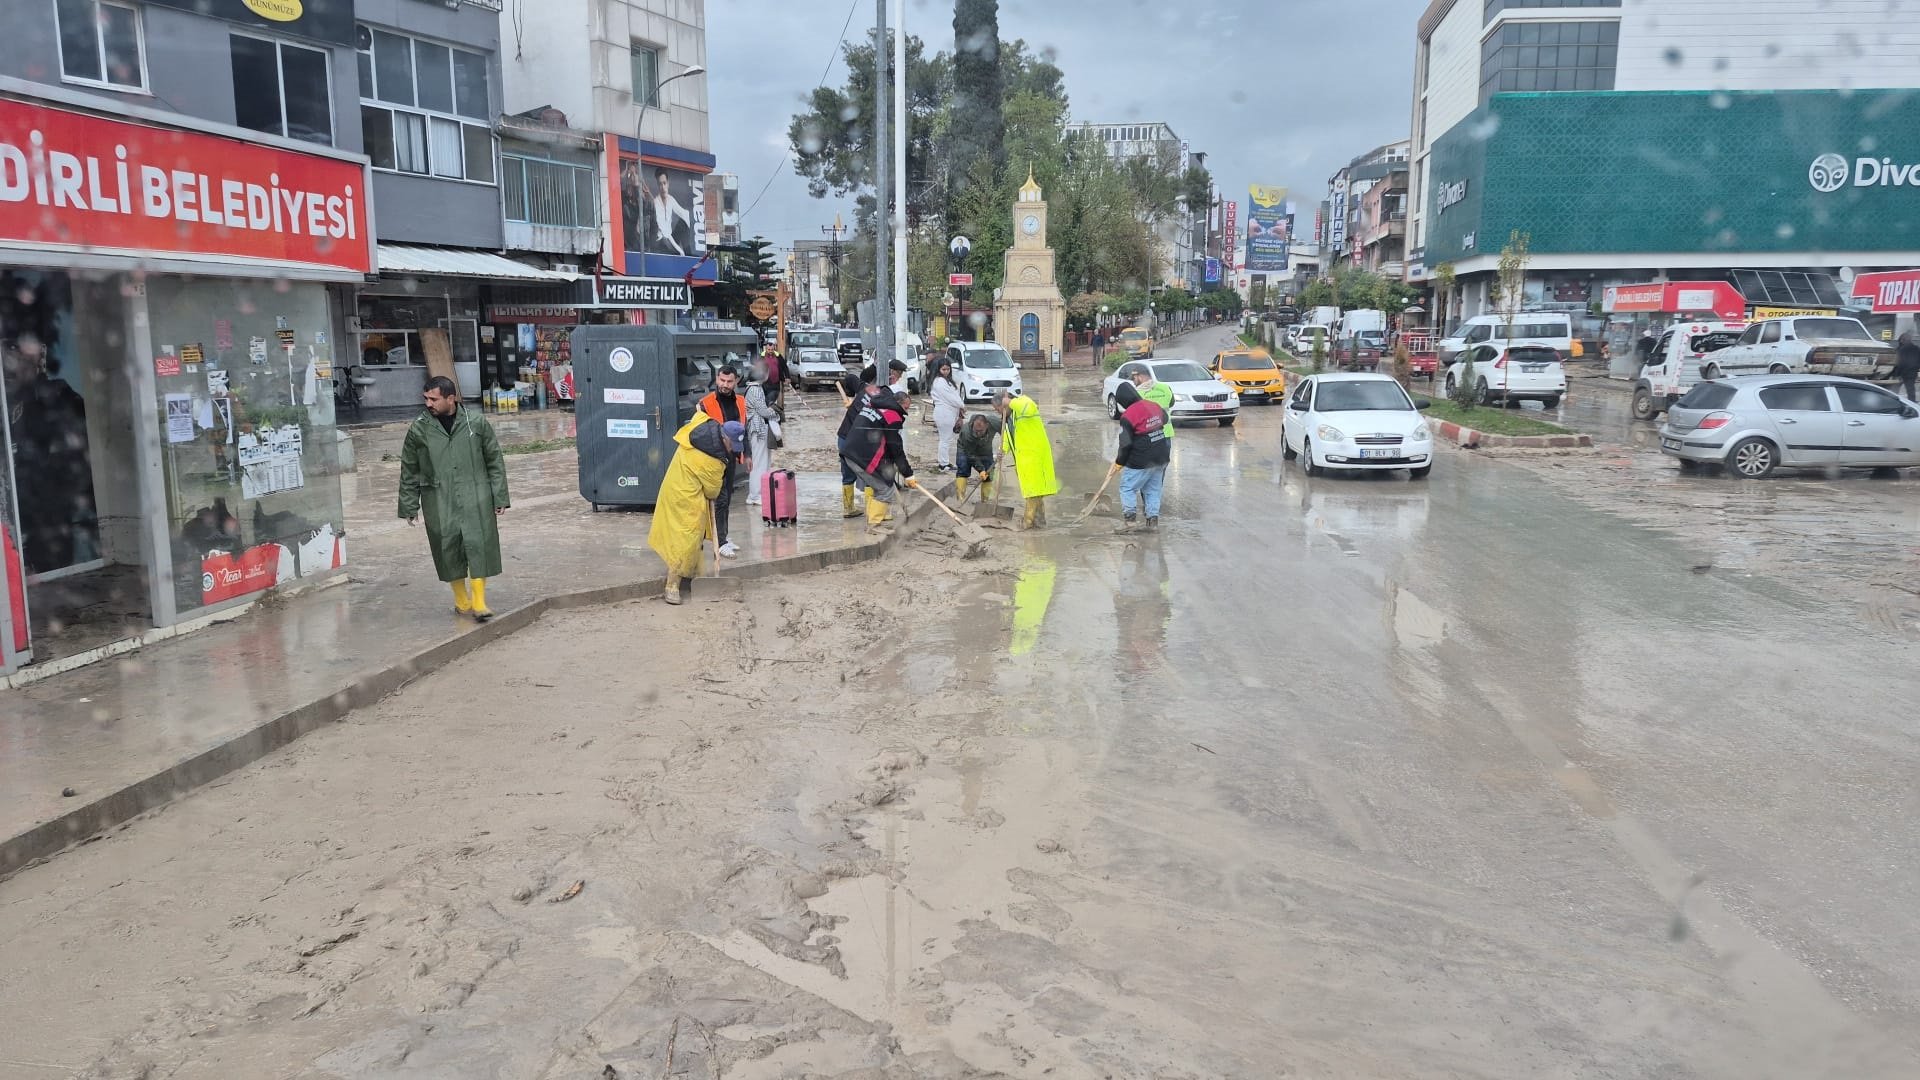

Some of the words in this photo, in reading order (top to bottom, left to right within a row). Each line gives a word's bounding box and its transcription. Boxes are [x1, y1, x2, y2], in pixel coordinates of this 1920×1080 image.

[0, 129, 131, 214] DİRLİ
[141, 165, 355, 240] BELEDİYESİ
[688, 179, 706, 252] mavi
[1878, 279, 1920, 306] TOPAK
